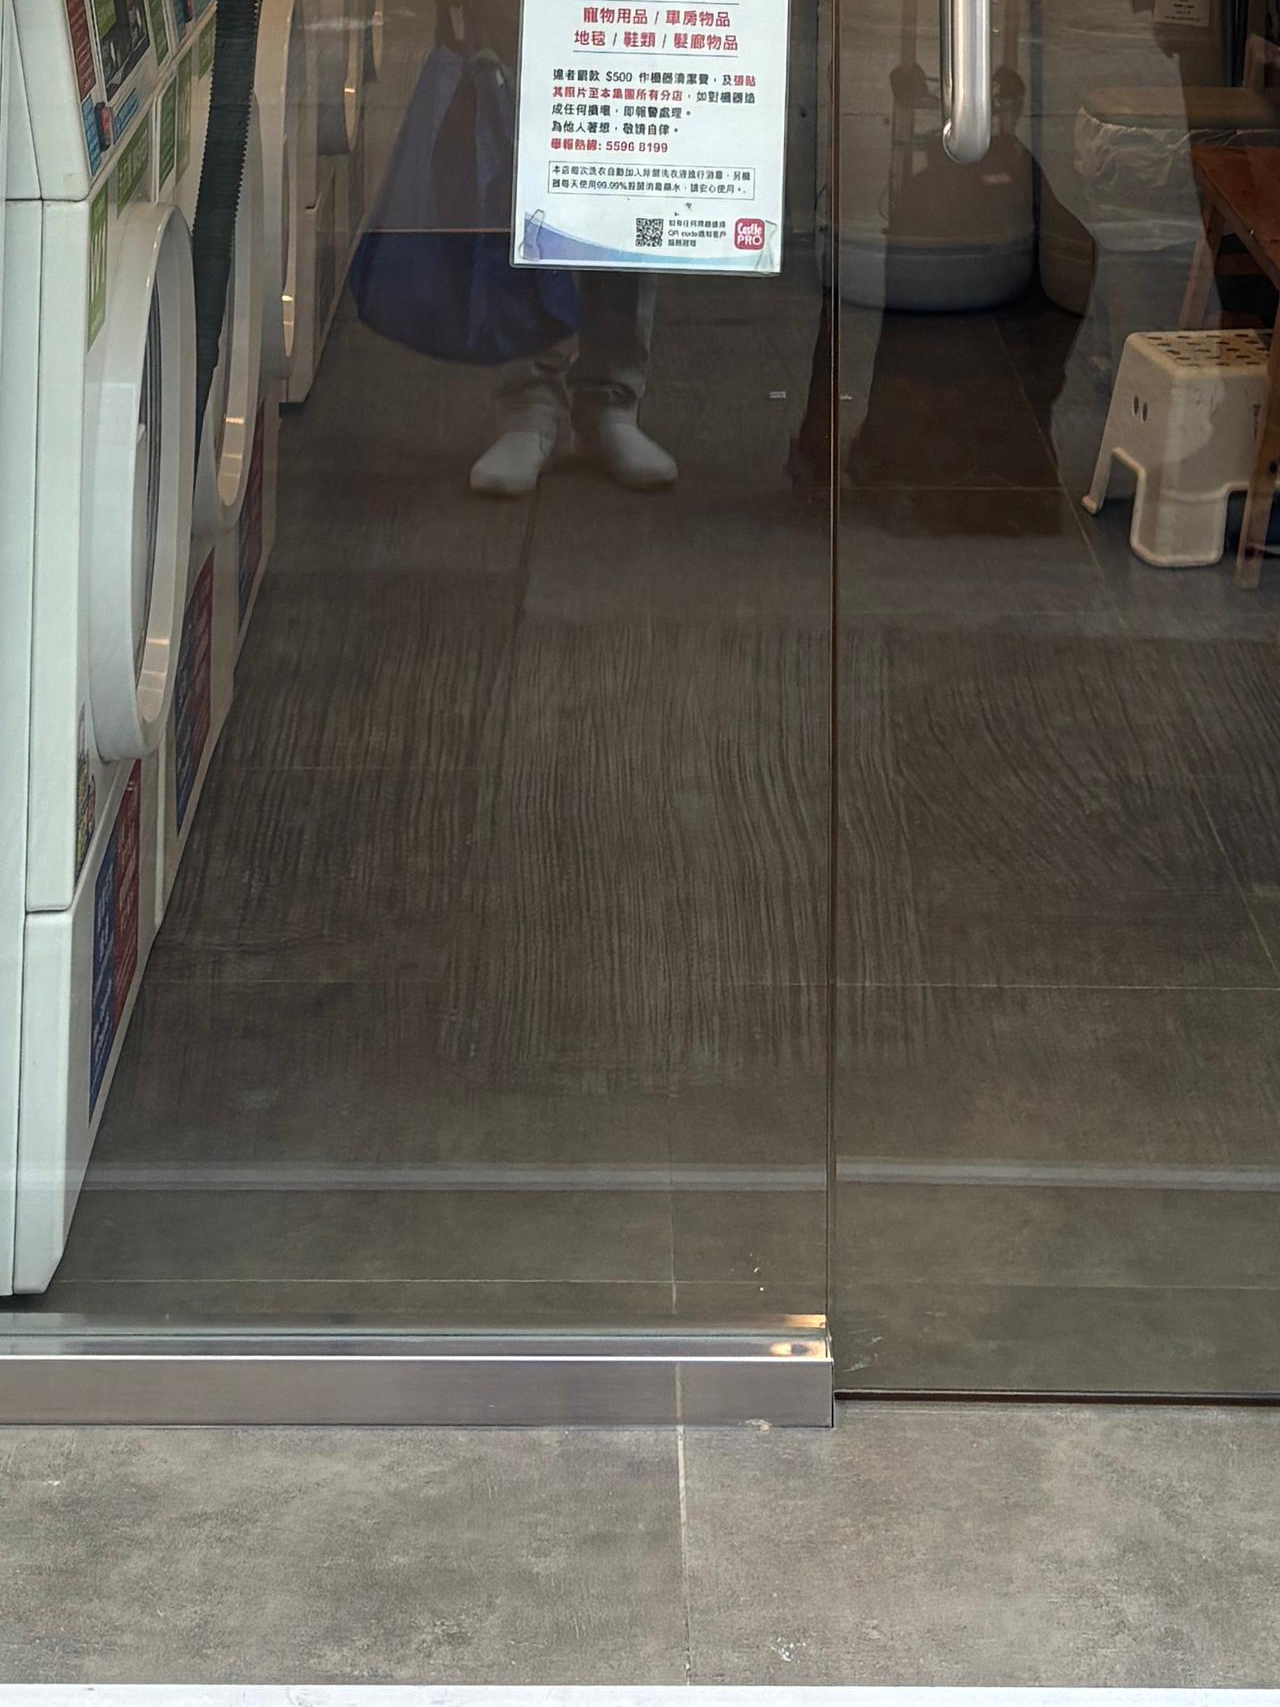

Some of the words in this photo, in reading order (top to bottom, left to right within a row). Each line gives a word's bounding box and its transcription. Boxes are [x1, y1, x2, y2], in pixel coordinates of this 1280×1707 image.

[583, 7, 648, 25] 寵物用品
[574, 29, 606, 47] 地毯
[623, 31, 656, 48] 鞋類
[605, 71, 633, 83] $500
[605, 140, 635, 153] 5596
[638, 142, 669, 154] 8199
[736, 235, 763, 246] PRO
